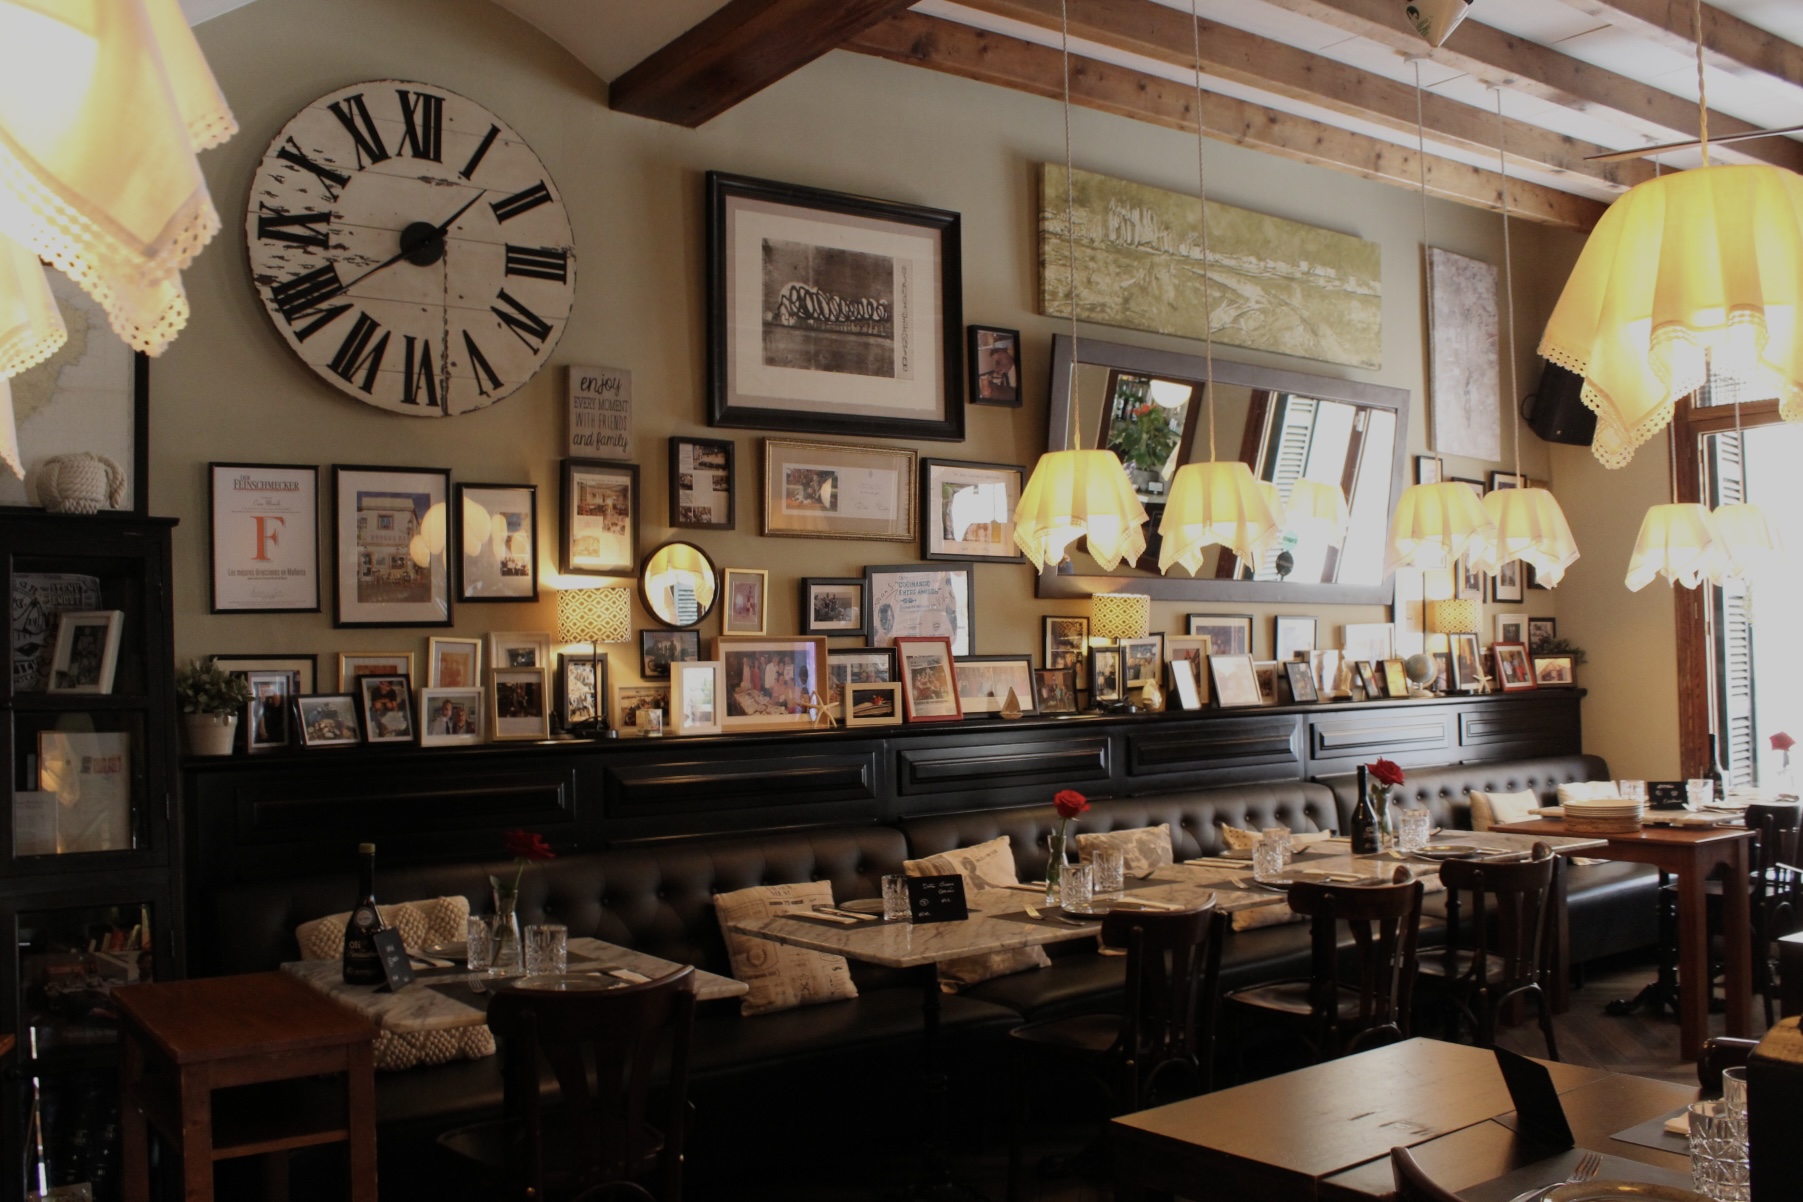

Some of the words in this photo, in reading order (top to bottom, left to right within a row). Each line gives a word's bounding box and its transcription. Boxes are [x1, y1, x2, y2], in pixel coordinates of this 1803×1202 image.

[327, 92, 393, 171] XI
[395, 89, 446, 163] XII
[458, 123, 501, 181] I
[276, 136, 351, 202] X
[257, 201, 332, 250] IX
[488, 179, 554, 225] II
[504, 242, 568, 285] III
[271, 262, 354, 344] VIII
[490, 287, 554, 356] IV
[327, 310, 392, 395] VII
[400, 334, 440, 407] VI
[462, 329, 504, 396] V
[573, 396, 597, 410] EVERY
[598, 398, 629, 413] MOMENT
[580, 373, 622, 397] enjoy
[573, 432, 594, 446] and
[596, 431, 629, 453] family
[575, 411, 595, 428] WITH
[598, 413, 628, 431] FRIENDS
[233, 479, 300, 491] FEINSCHMECKER
[249, 515, 286, 561] F
